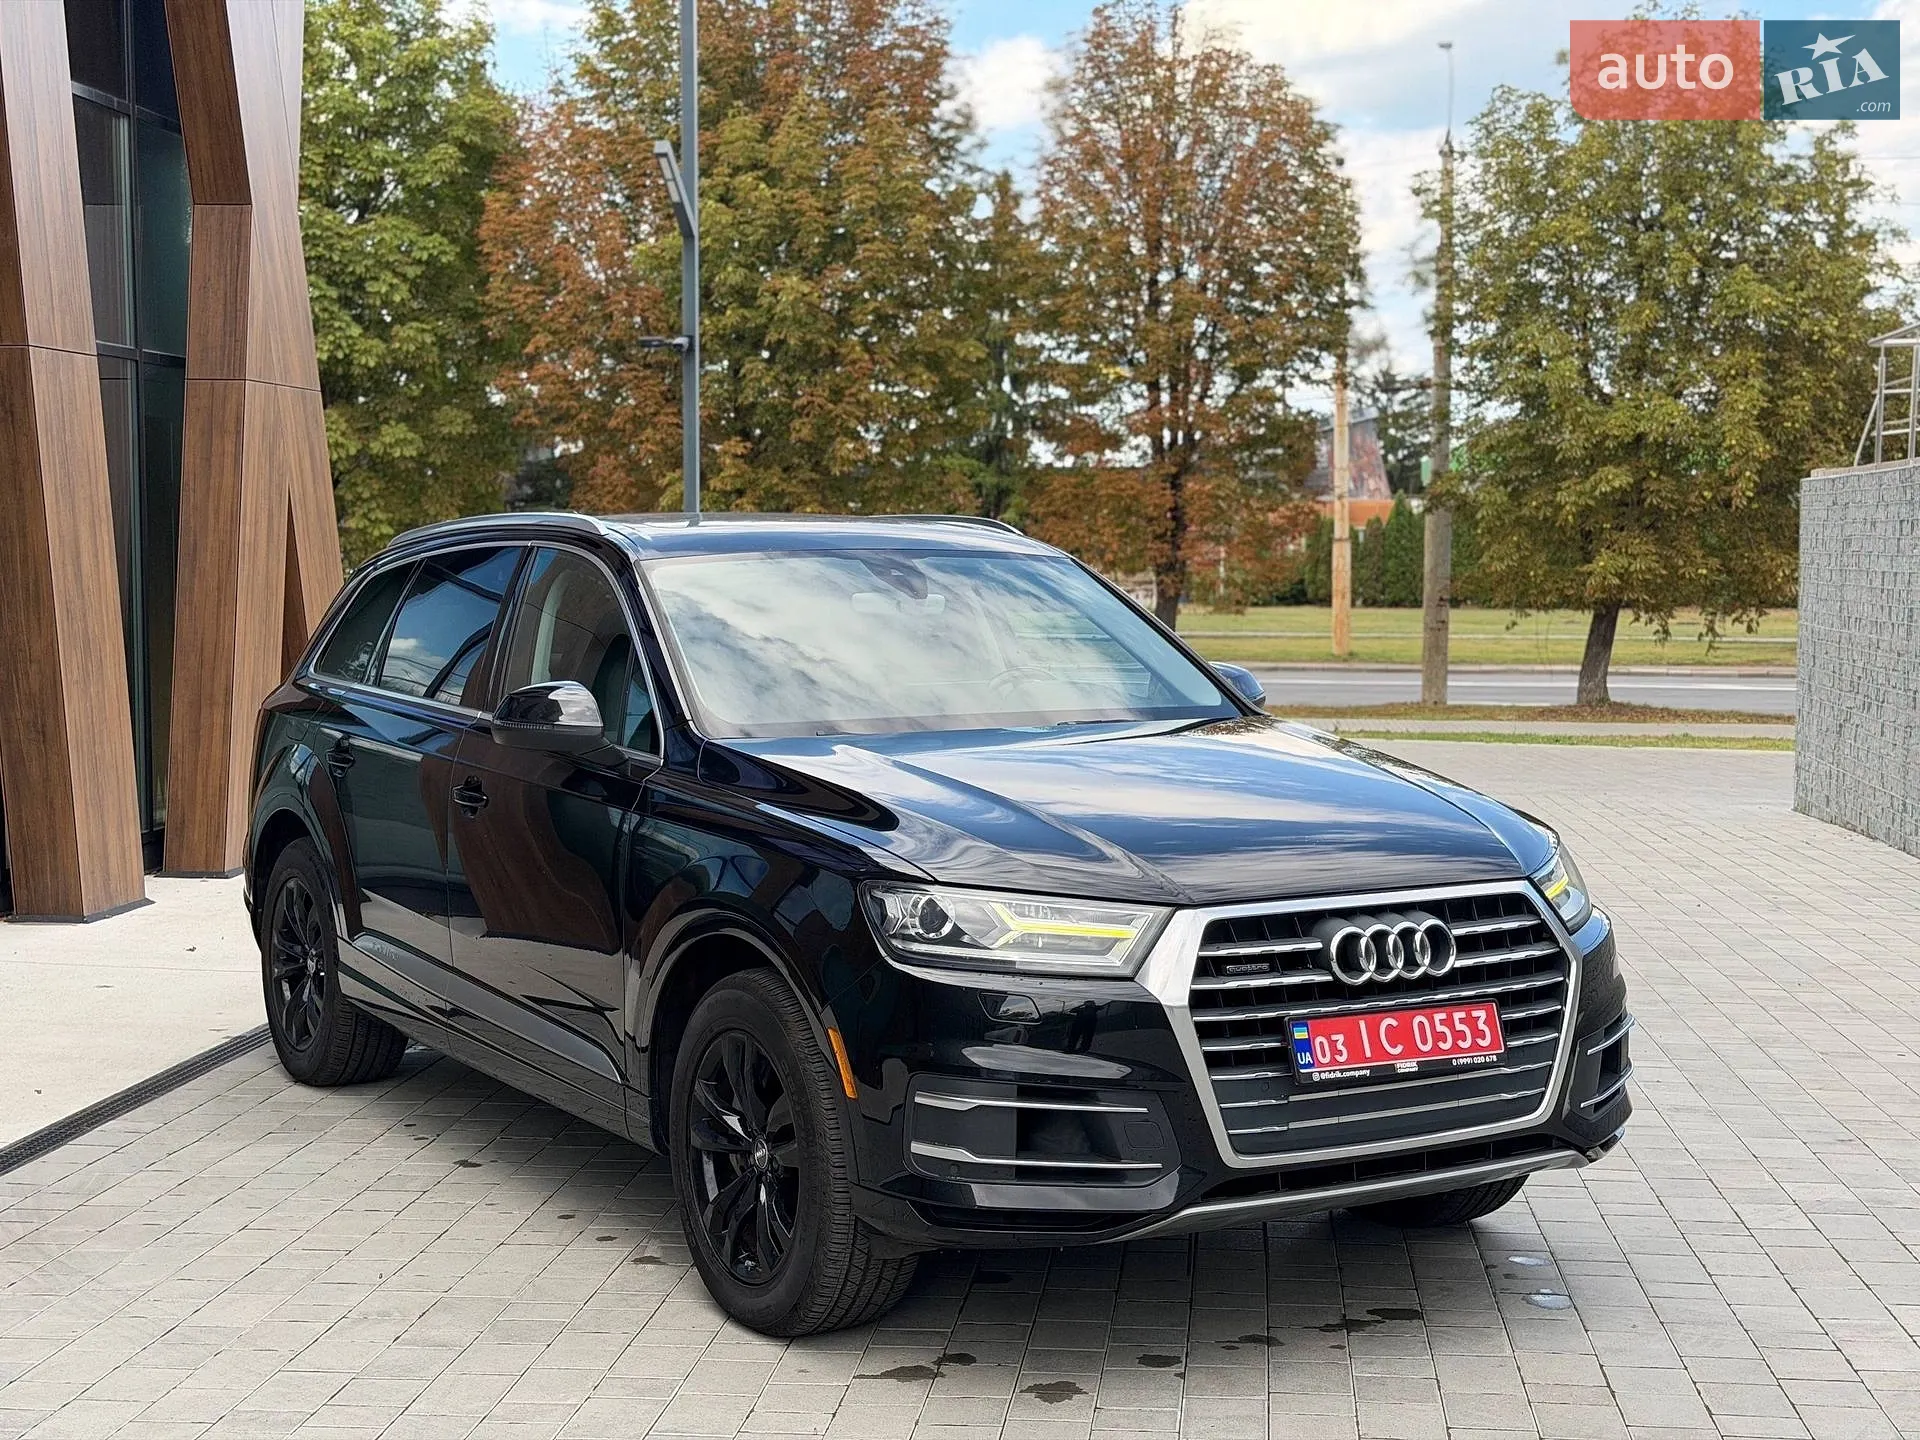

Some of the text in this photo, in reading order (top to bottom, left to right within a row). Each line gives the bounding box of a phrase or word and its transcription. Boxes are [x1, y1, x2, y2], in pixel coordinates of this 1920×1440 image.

[1313, 1009, 1492, 1065] 03 IC 0553
[1297, 1051, 1314, 1065] UA
